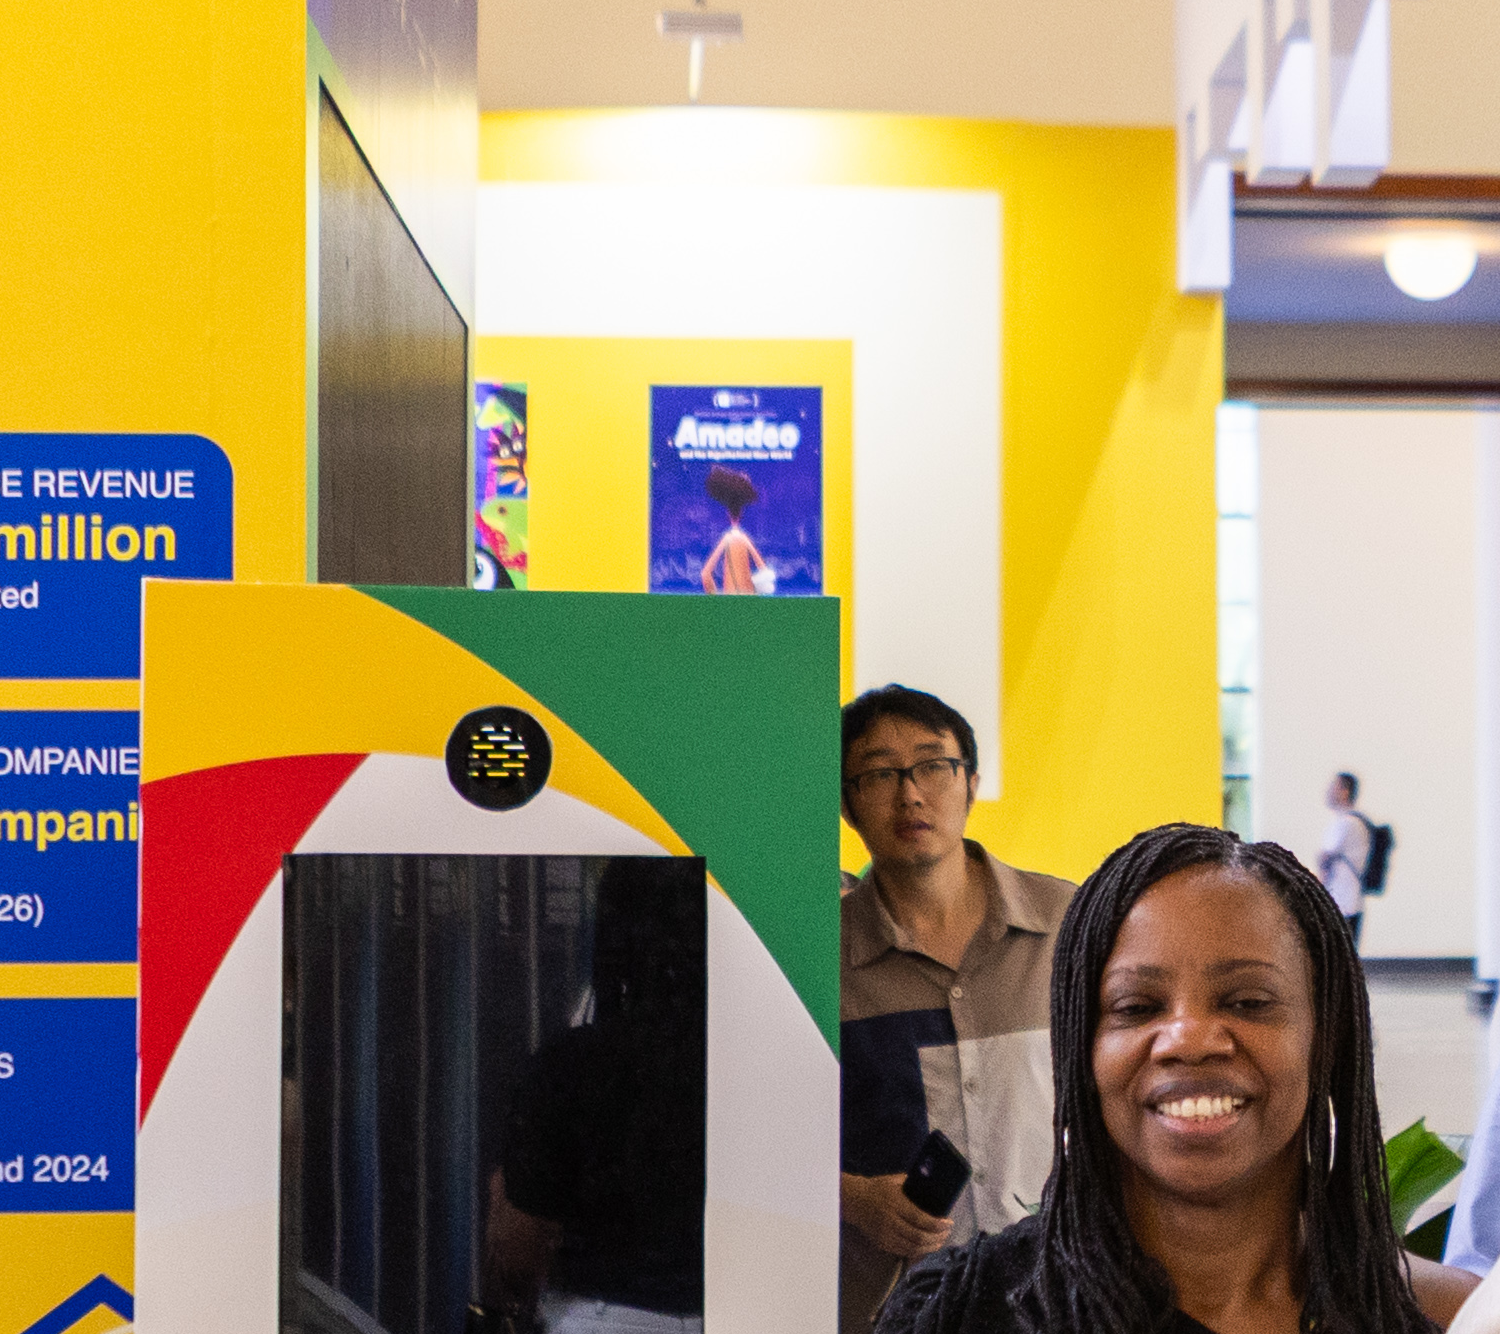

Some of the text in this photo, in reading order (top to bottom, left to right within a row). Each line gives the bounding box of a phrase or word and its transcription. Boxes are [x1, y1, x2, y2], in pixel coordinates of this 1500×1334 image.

[675, 416, 800, 449] Amadeo
[33, 469, 195, 499] REVENUE
[32, 1154, 110, 1183] 2024
